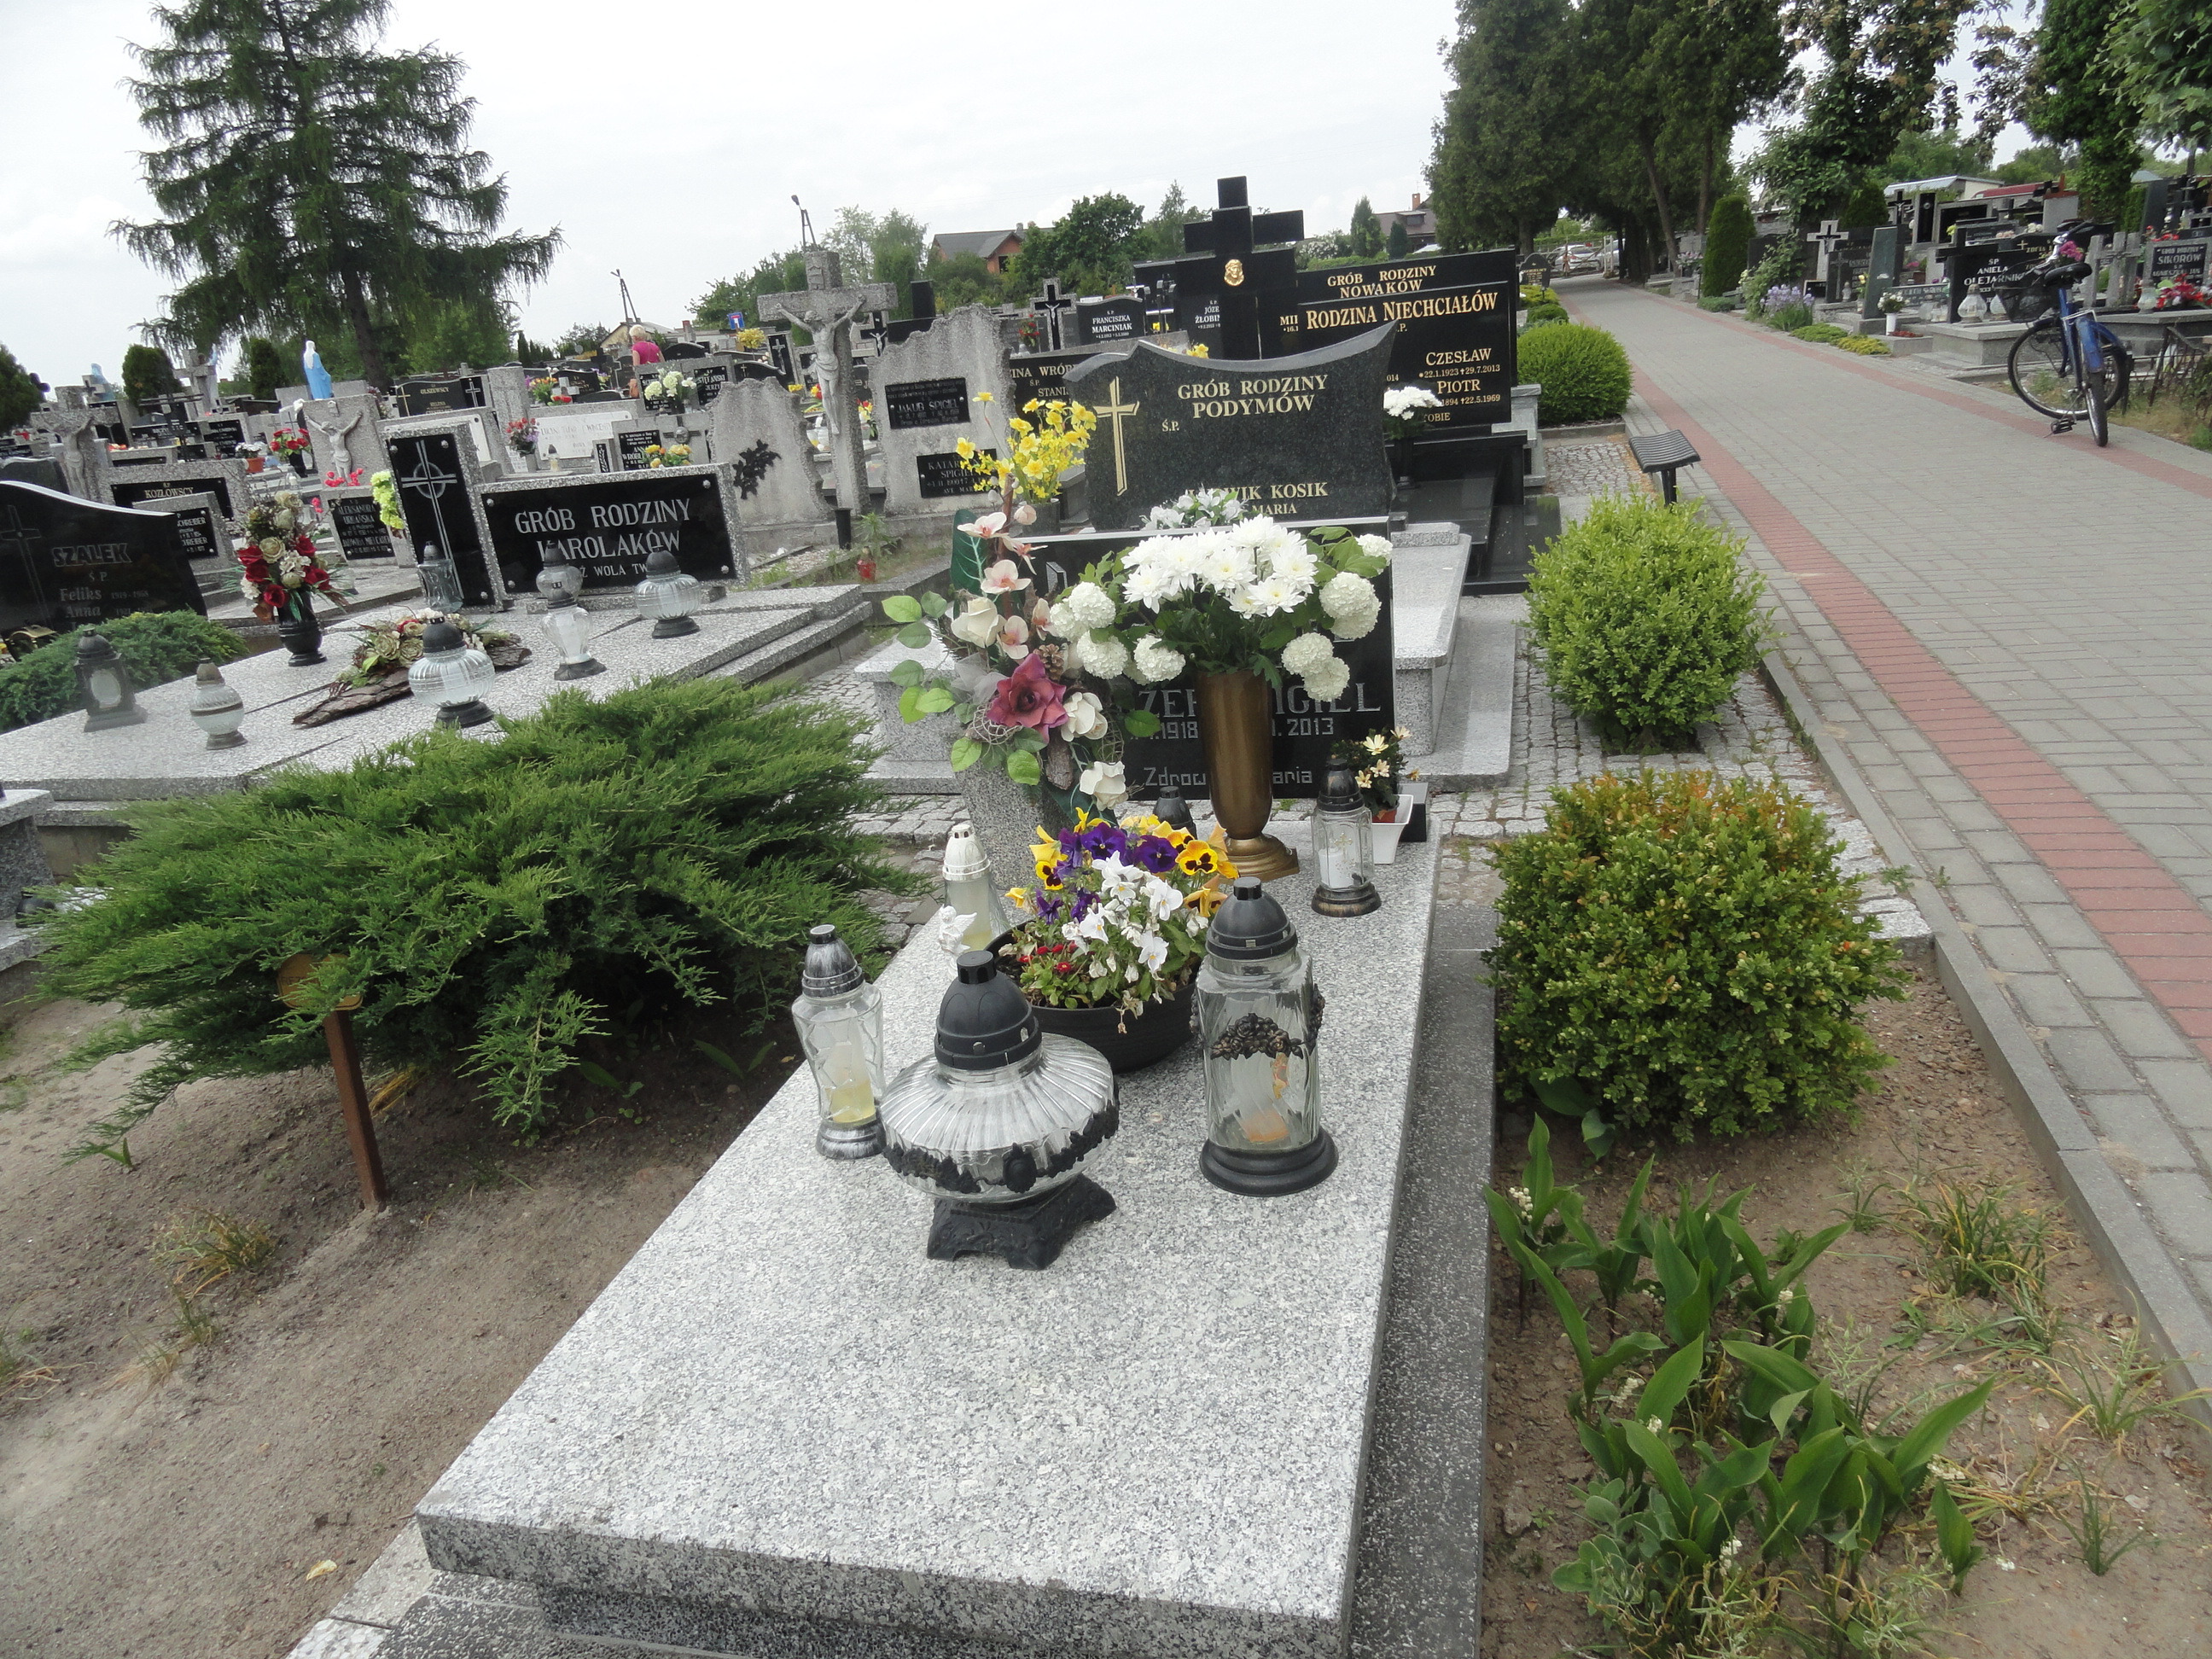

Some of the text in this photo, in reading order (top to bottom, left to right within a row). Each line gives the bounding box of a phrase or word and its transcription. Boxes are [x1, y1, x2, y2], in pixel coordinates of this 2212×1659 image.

[1327, 265, 1437, 287] GRÓB RODZINY
[1977, 265, 2009, 275] ANIELA
[1340, 278, 1423, 299] NOWAKÓW
[1307, 289, 1499, 330] RODZINA NIECHCIAŁÓW
[1092, 315, 1131, 325] FRANCISZKA
[1091, 323, 1133, 334] MARCINIAK
[1425, 348, 1493, 367] CZESŁAW
[1038, 386, 1069, 398] STANI
[1177, 374, 1329, 400] GRÓB RODZINY
[1437, 379, 1481, 394] PIOTR
[897, 402, 926, 414] JAKUB
[1191, 391, 1315, 419] PODYMÓW
[1161, 418, 1180, 432] Ś.P.
[1270, 481, 1329, 499] KOSIK
[515, 498, 690, 534] GRÓB RODZINY
[1251, 502, 1297, 515] MARIA
[51, 542, 133, 568] SZALEK
[594, 563, 626, 578] WOLA
[60, 586, 102, 602] Feliks
[66, 605, 102, 619] Anna
